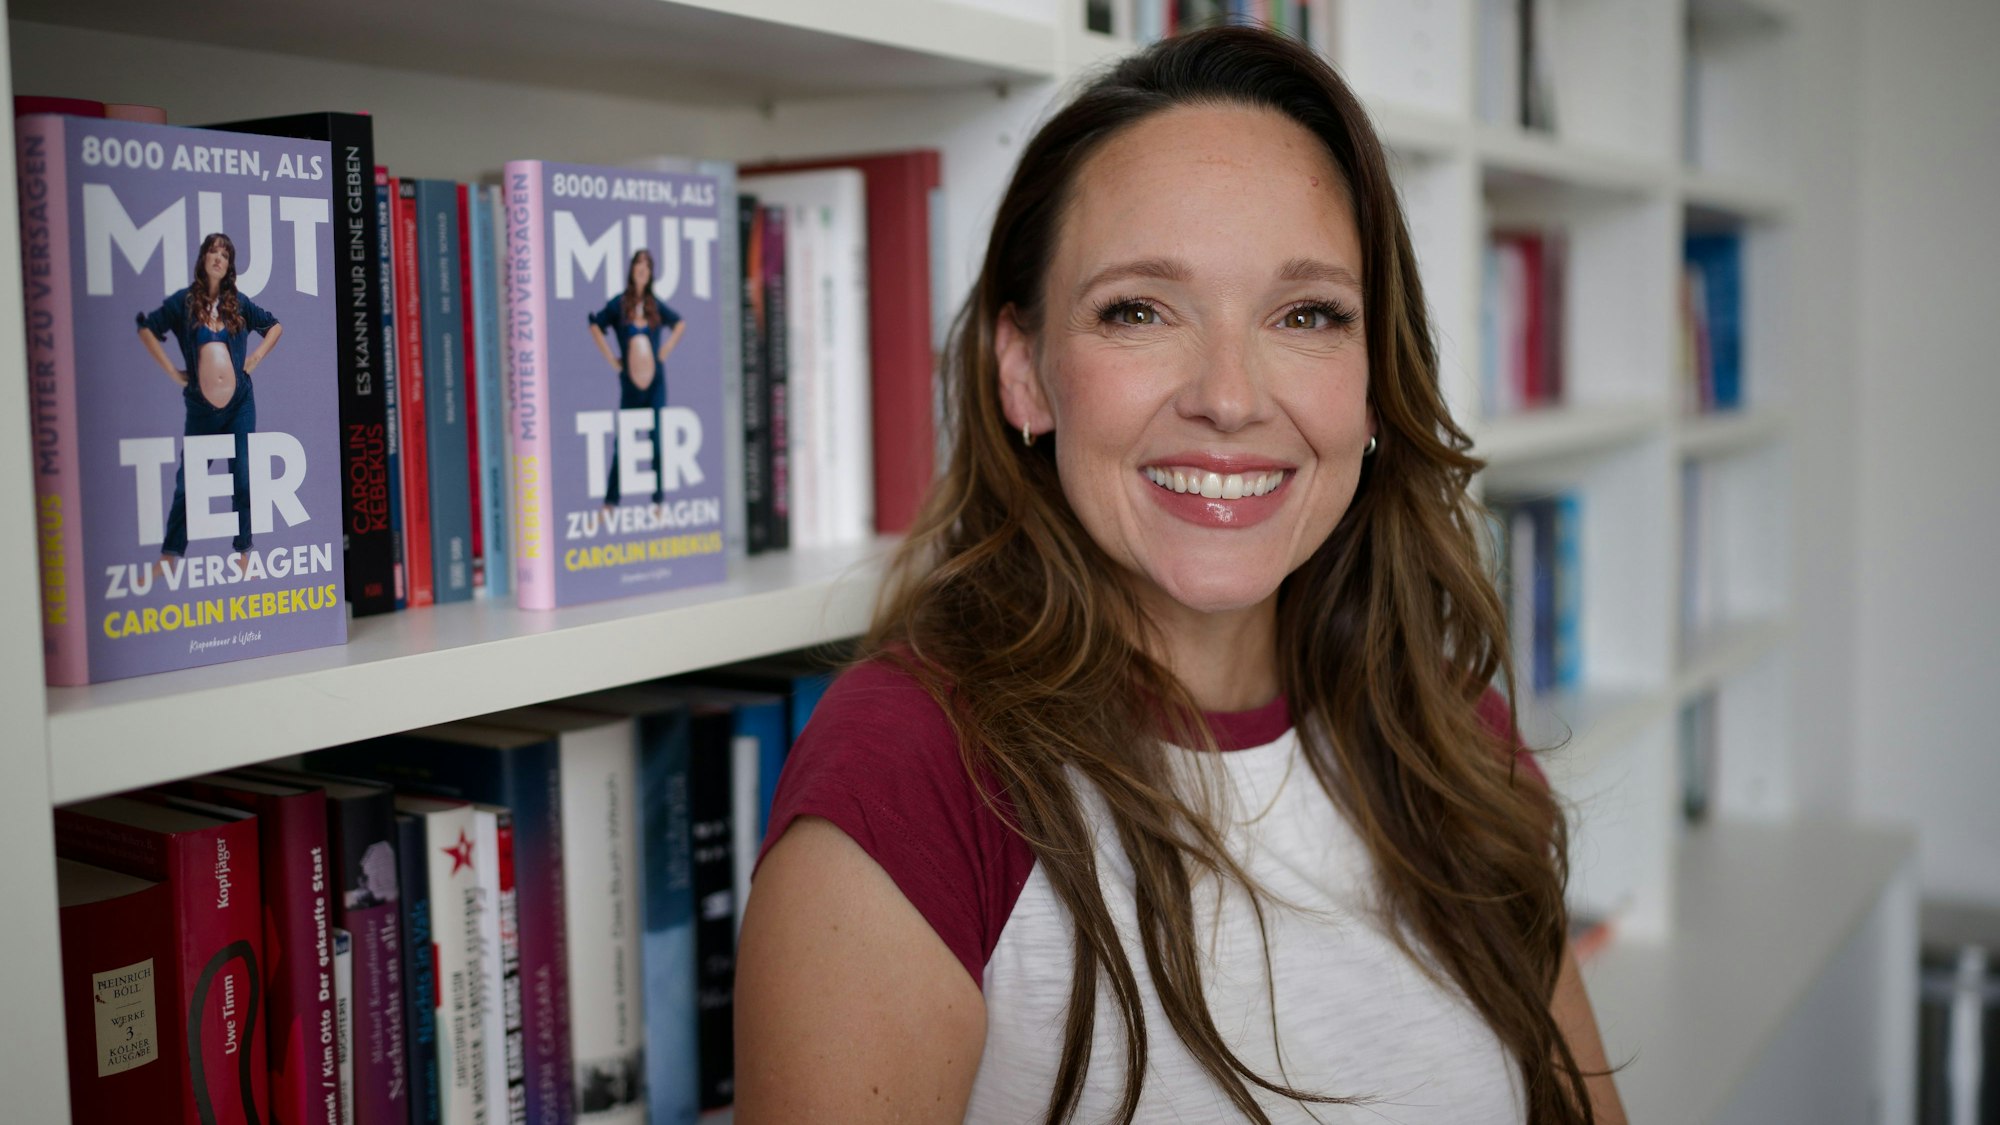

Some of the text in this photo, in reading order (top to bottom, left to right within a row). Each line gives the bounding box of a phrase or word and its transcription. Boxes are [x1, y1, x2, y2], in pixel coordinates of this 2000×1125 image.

[82, 135, 324, 182] 8000 ARTEN, ALS
[553, 173, 715, 208] 8000 ARTEN, ALS
[82, 183, 329, 300] MUT
[553, 210, 719, 301] MUT
[345, 146, 372, 397] ES KANN NUR EINE GEBEN
[24, 135, 60, 476] MUTTER ZU VERSAGEN
[511, 173, 537, 441] MUTTER ZU VERSAGEN
[348, 424, 371, 535] CAROLIN
[366, 422, 388, 531] KEBEKUS
[575, 406, 705, 498] TER
[119, 431, 311, 546] TER
[521, 455, 541, 559] KEBEKUS
[565, 497, 721, 540] ZU VERSAGEN
[40, 494, 67, 626] KEBEKUS
[104, 543, 333, 599] ZU VERSAGEN
[564, 531, 723, 572] CAROLIN KEBEKUS
[103, 600, 224, 640] CAROLIN
[230, 584, 338, 621] KEBEKUS
[215, 837, 232, 910] Kopfjäger
[311, 847, 324, 893] Staat
[314, 896, 330, 968] gekaufte
[97, 967, 151, 990] HEINRICH
[113, 983, 141, 999] BÖLL
[318, 972, 331, 1002] Der
[380, 912, 404, 1101] Nachricht an alle
[111, 1010, 145, 1026] WERKE
[126, 1026, 134, 1042] 3
[222, 974, 238, 1055] Uwe Timm
[320, 1008, 333, 1045] Otto
[108, 1046, 151, 1067] AUSGABE
[110, 1038, 150, 1057] KÖLNER
[322, 1045, 335, 1078] Kim
[323, 1091, 338, 1125] mek
[540, 1062, 560, 1125] OSEPH
